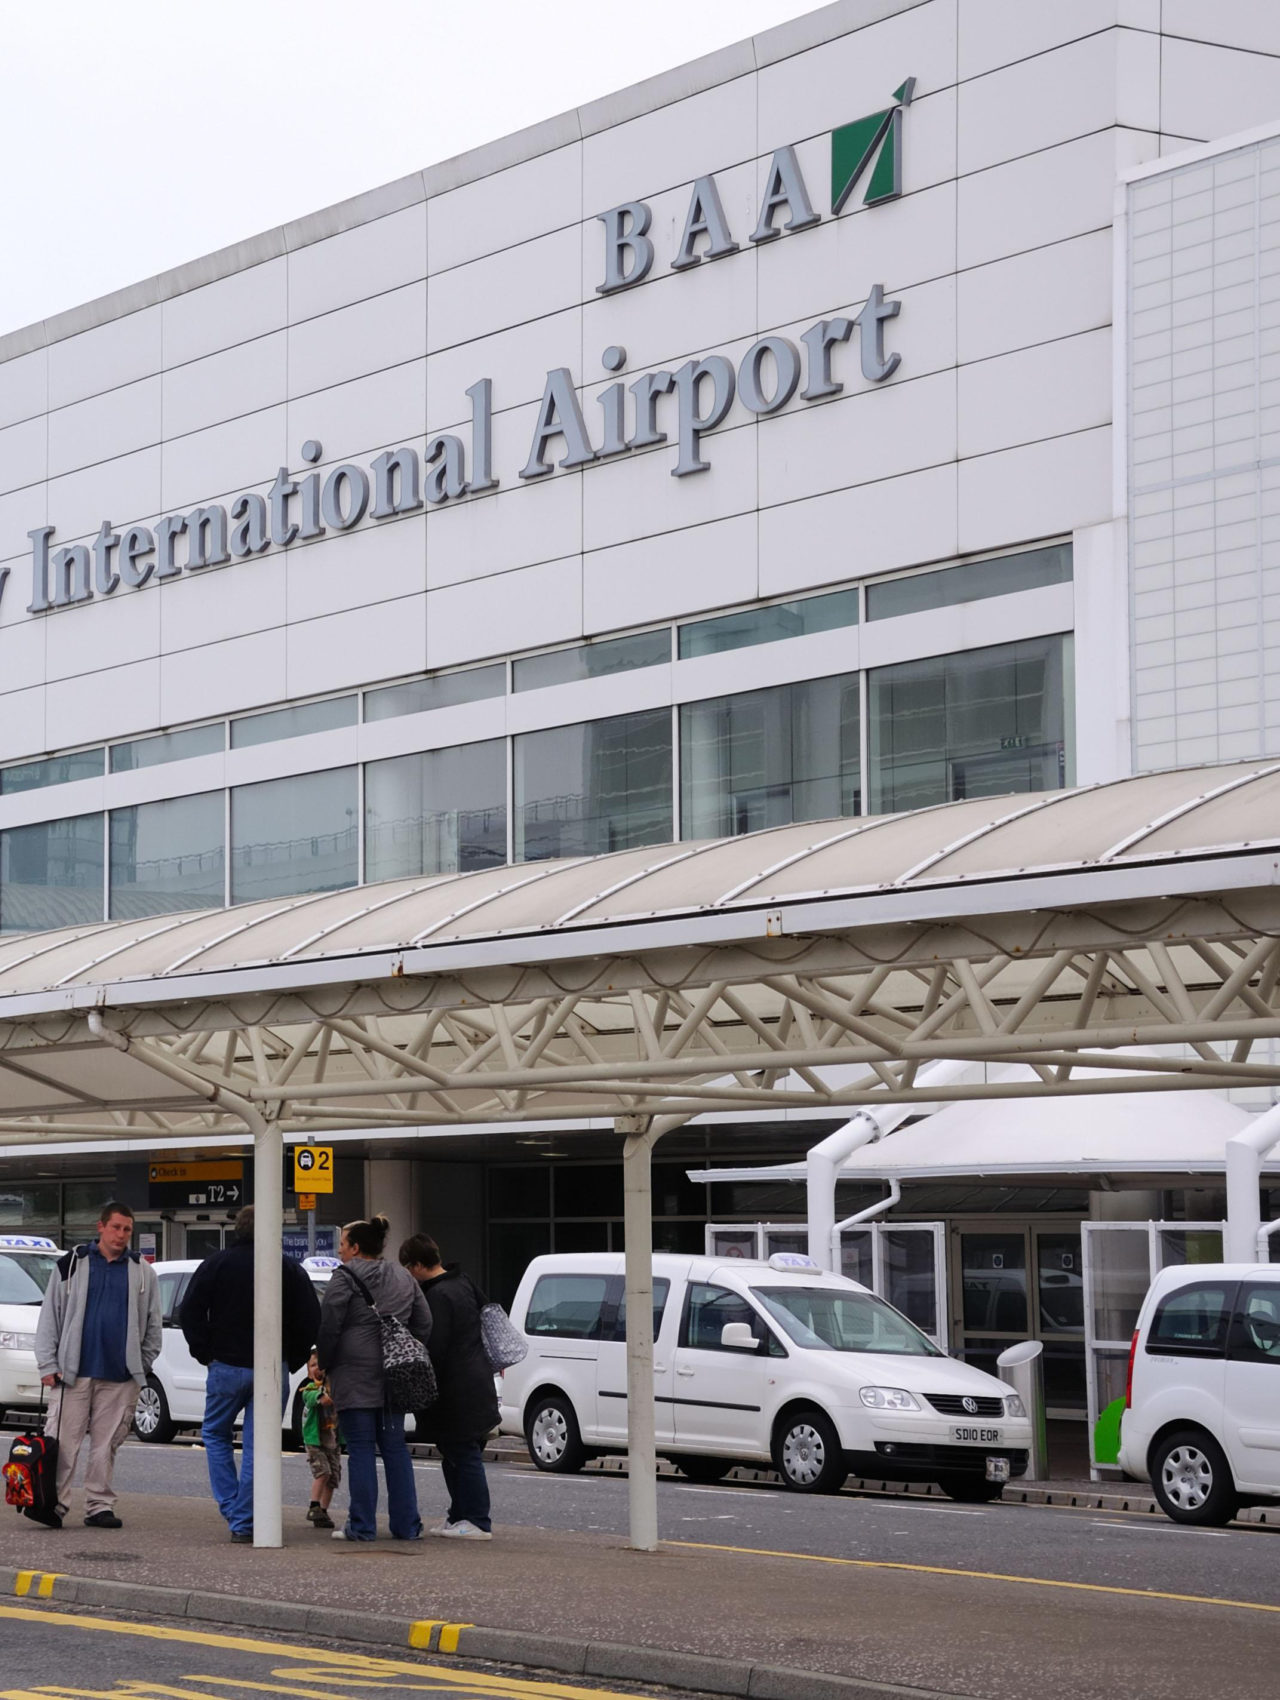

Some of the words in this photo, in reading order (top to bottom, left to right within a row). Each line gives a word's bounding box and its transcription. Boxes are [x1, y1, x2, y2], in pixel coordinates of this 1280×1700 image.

[596, 145, 821, 295] BAA
[27, 378, 499, 614] International
[519, 284, 901, 479] Airport
[318, 1151, 330, 1171] 2
[158, 1167, 178, 1176] Check
[179, 1167, 187, 1176] in
[208, 1185, 225, 1202] T2
[1, 1239, 52, 1248] TAXI
[315, 1238, 328, 1248] you
[955, 1428, 978, 1440] SD10
[980, 1429, 999, 1441] EOR
